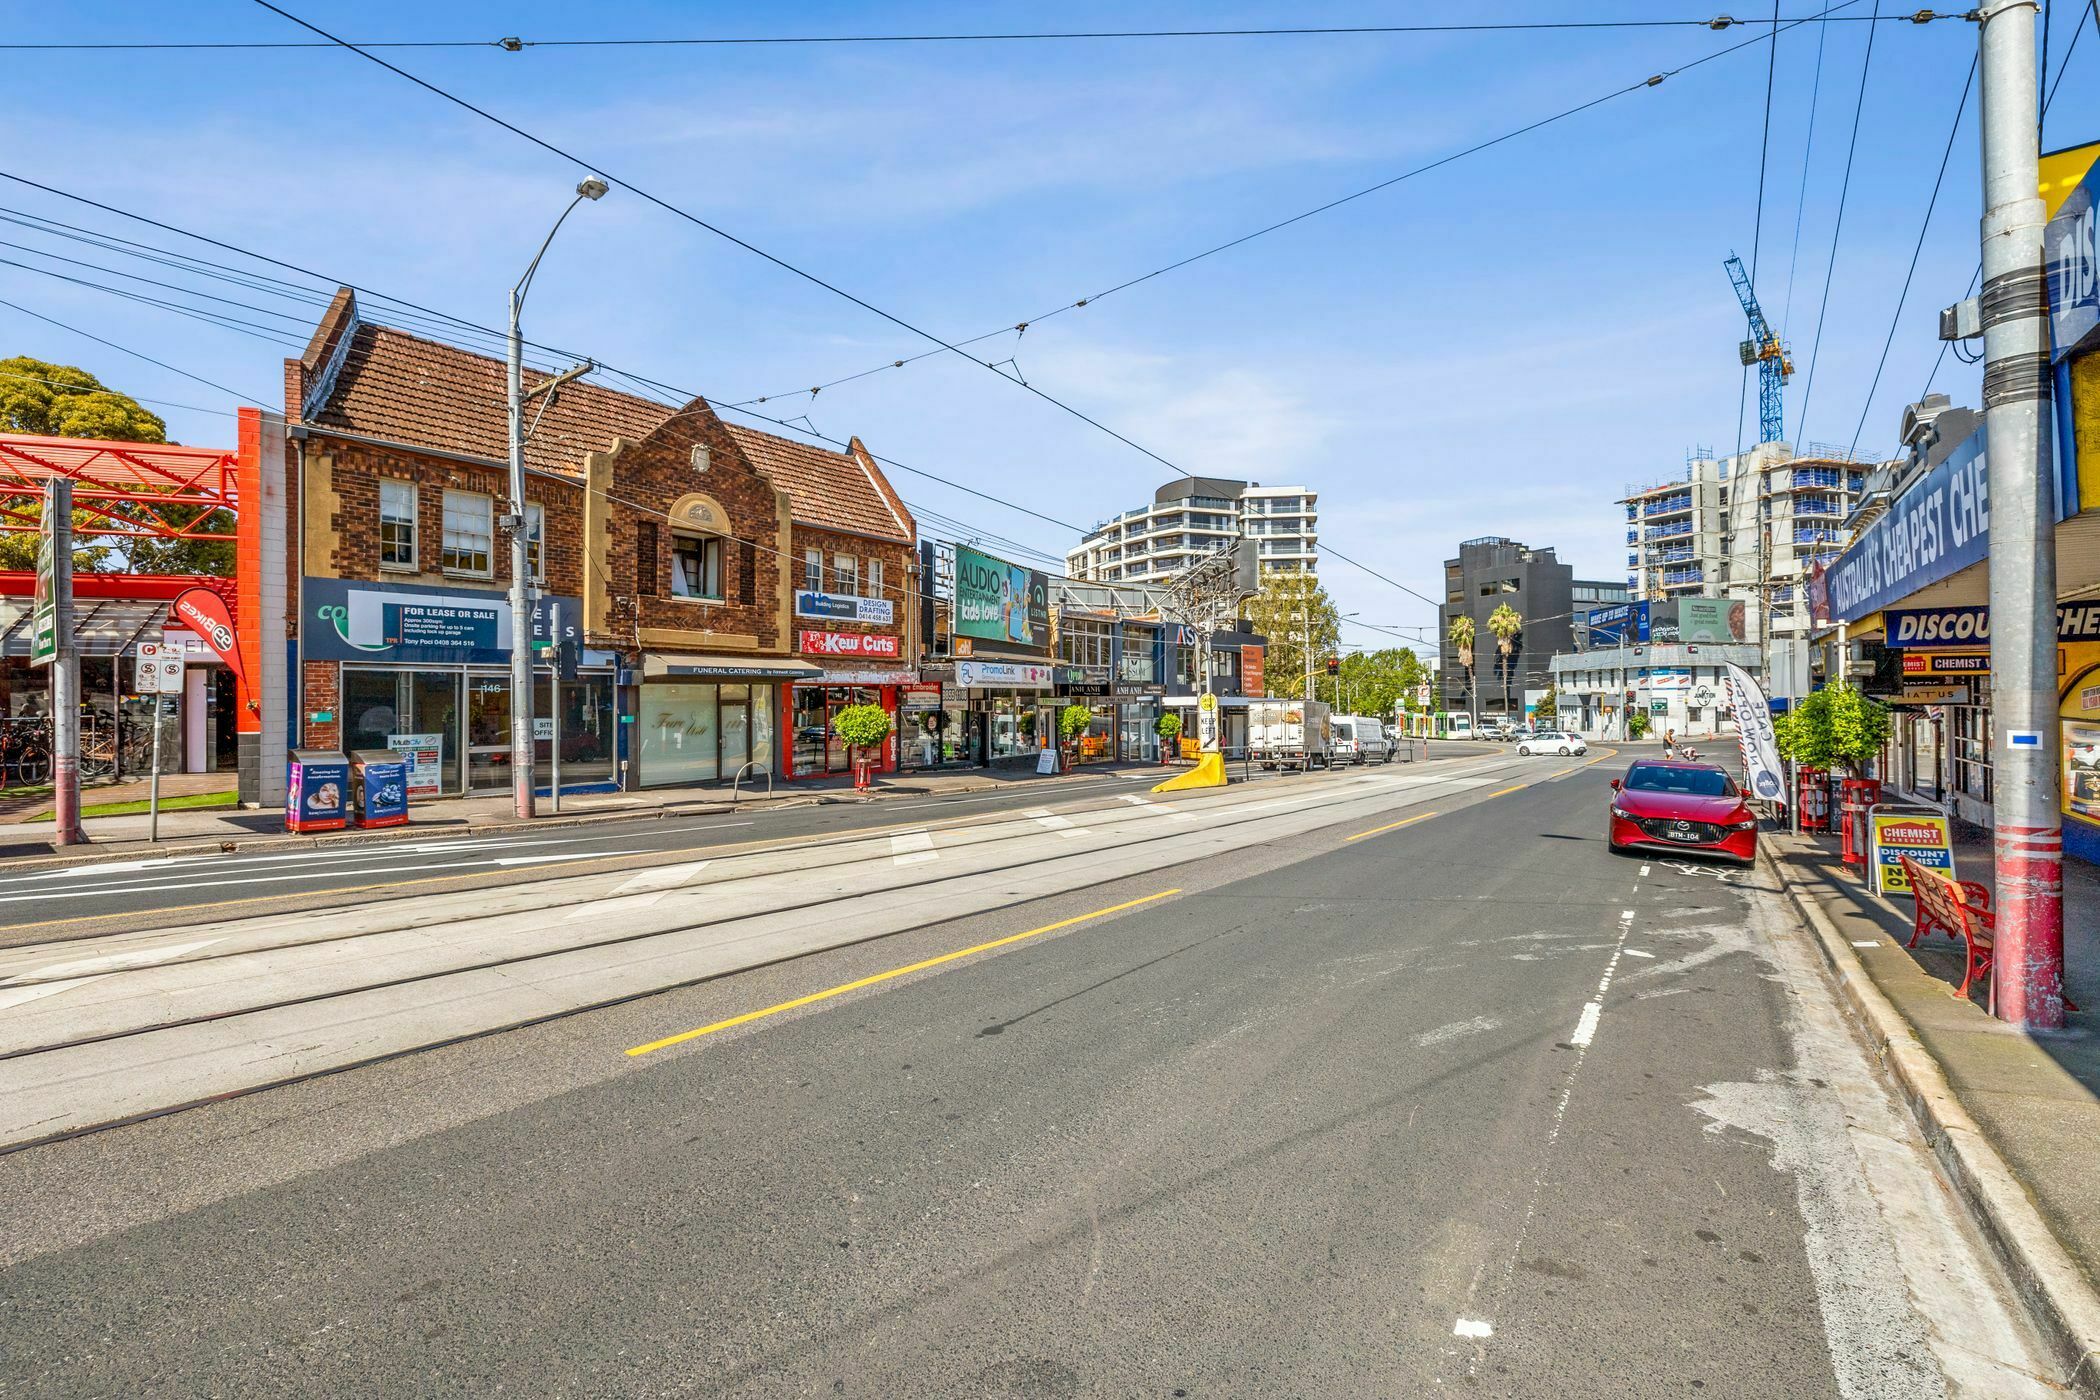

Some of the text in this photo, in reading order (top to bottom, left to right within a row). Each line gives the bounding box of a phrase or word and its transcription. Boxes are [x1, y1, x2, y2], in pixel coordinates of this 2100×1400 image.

[1836, 541, 1881, 615] AUSTRALIA'S
[1883, 487, 1944, 588] CHEAPEST
[960, 561, 1000, 594] AUDIO
[960, 586, 1000, 605] ENTERTAINMENT
[859, 606, 890, 615] DRAFTING
[863, 600, 887, 608] DESIGN
[962, 598, 998, 622] kids love
[317, 605, 348, 620] CO
[404, 607, 495, 620] FOR LEASE OR SALE
[1898, 612, 1990, 640] DISCOU
[825, 633, 894, 654] Kew Cuts
[982, 664, 1016, 675] PromoLink
[1935, 658, 1982, 668] CHEMIST
[1116, 686, 1129, 694] ANH
[1130, 686, 1142, 694] ANH
[1884, 828, 1938, 838] CHEMIST
[1881, 848, 1946, 858] DISCOUNT
